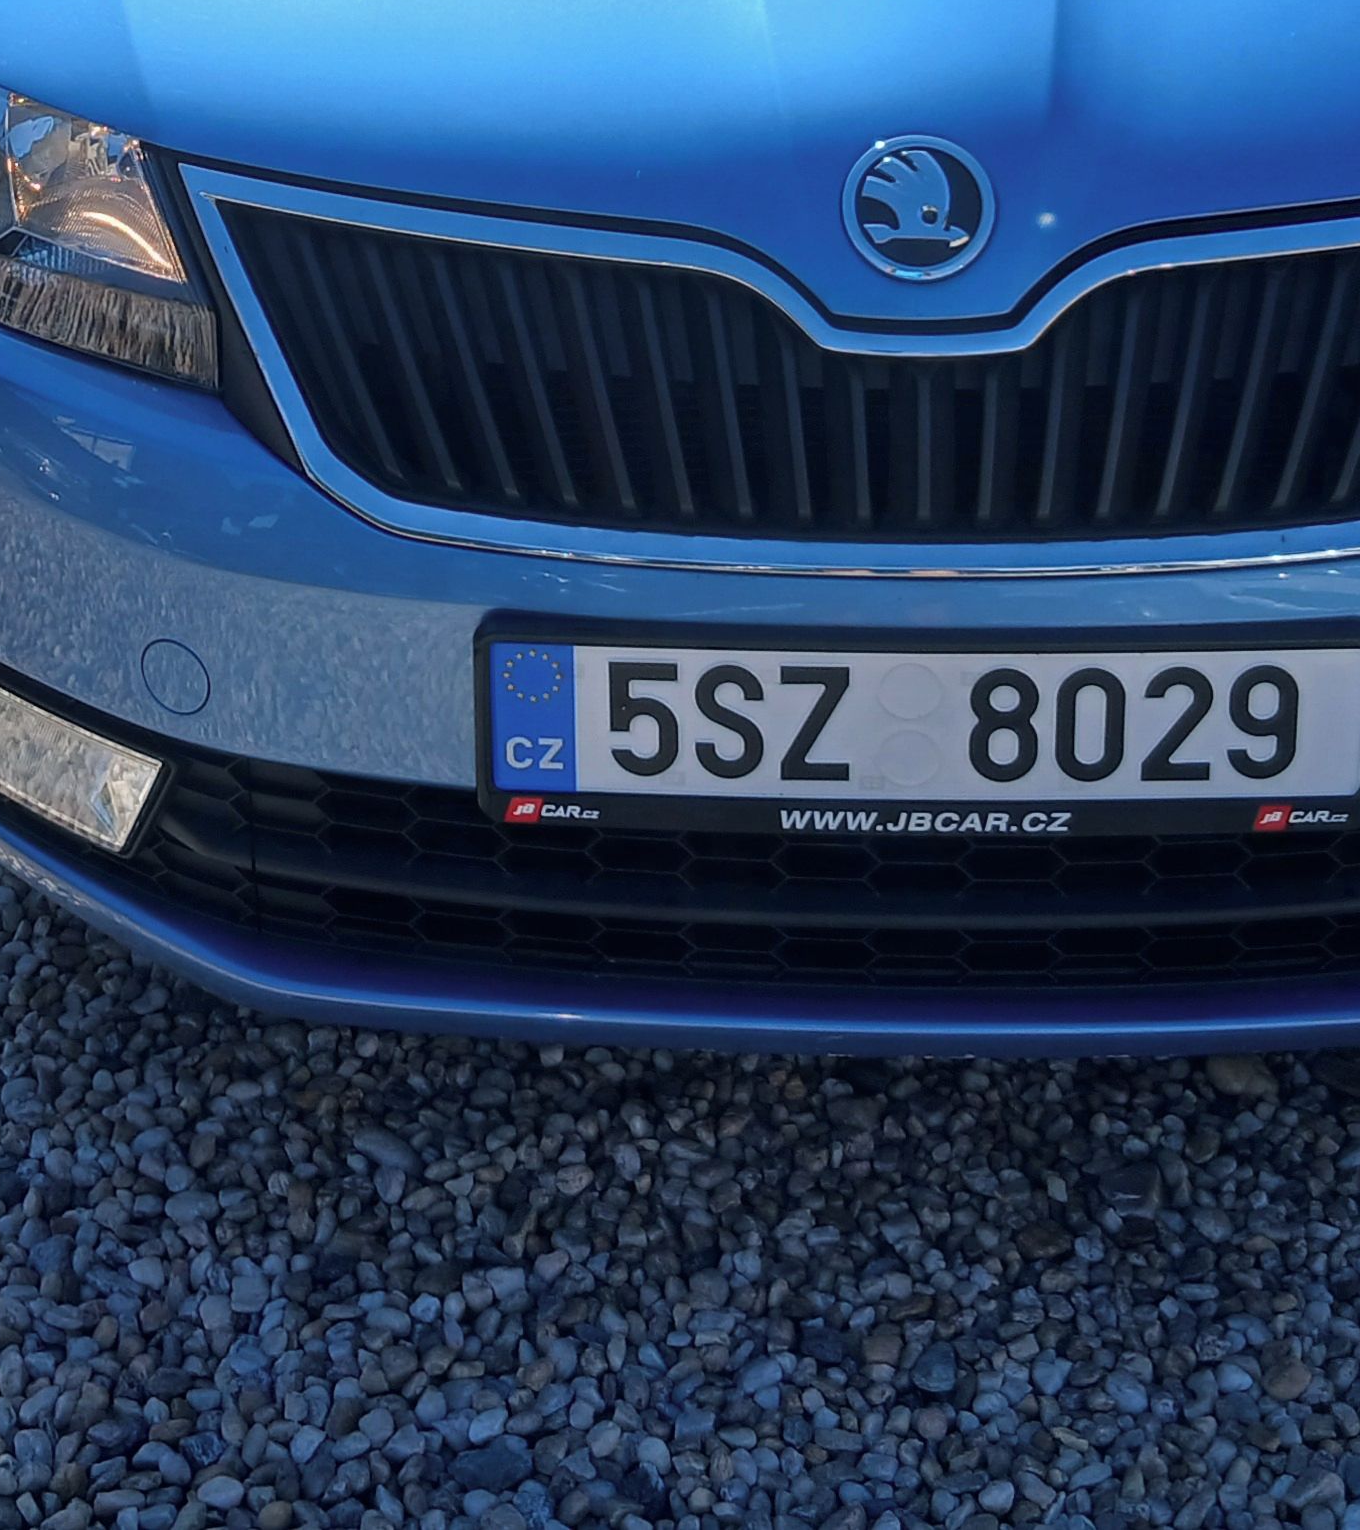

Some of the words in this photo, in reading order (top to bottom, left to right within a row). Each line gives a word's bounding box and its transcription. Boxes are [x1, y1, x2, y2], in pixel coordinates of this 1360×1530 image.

[608, 661, 850, 782] 5SZ
[968, 664, 1299, 783] 8029
[506, 737, 564, 770] CZ
[780, 810, 1072, 833] WWW.JBCAR.CZ
